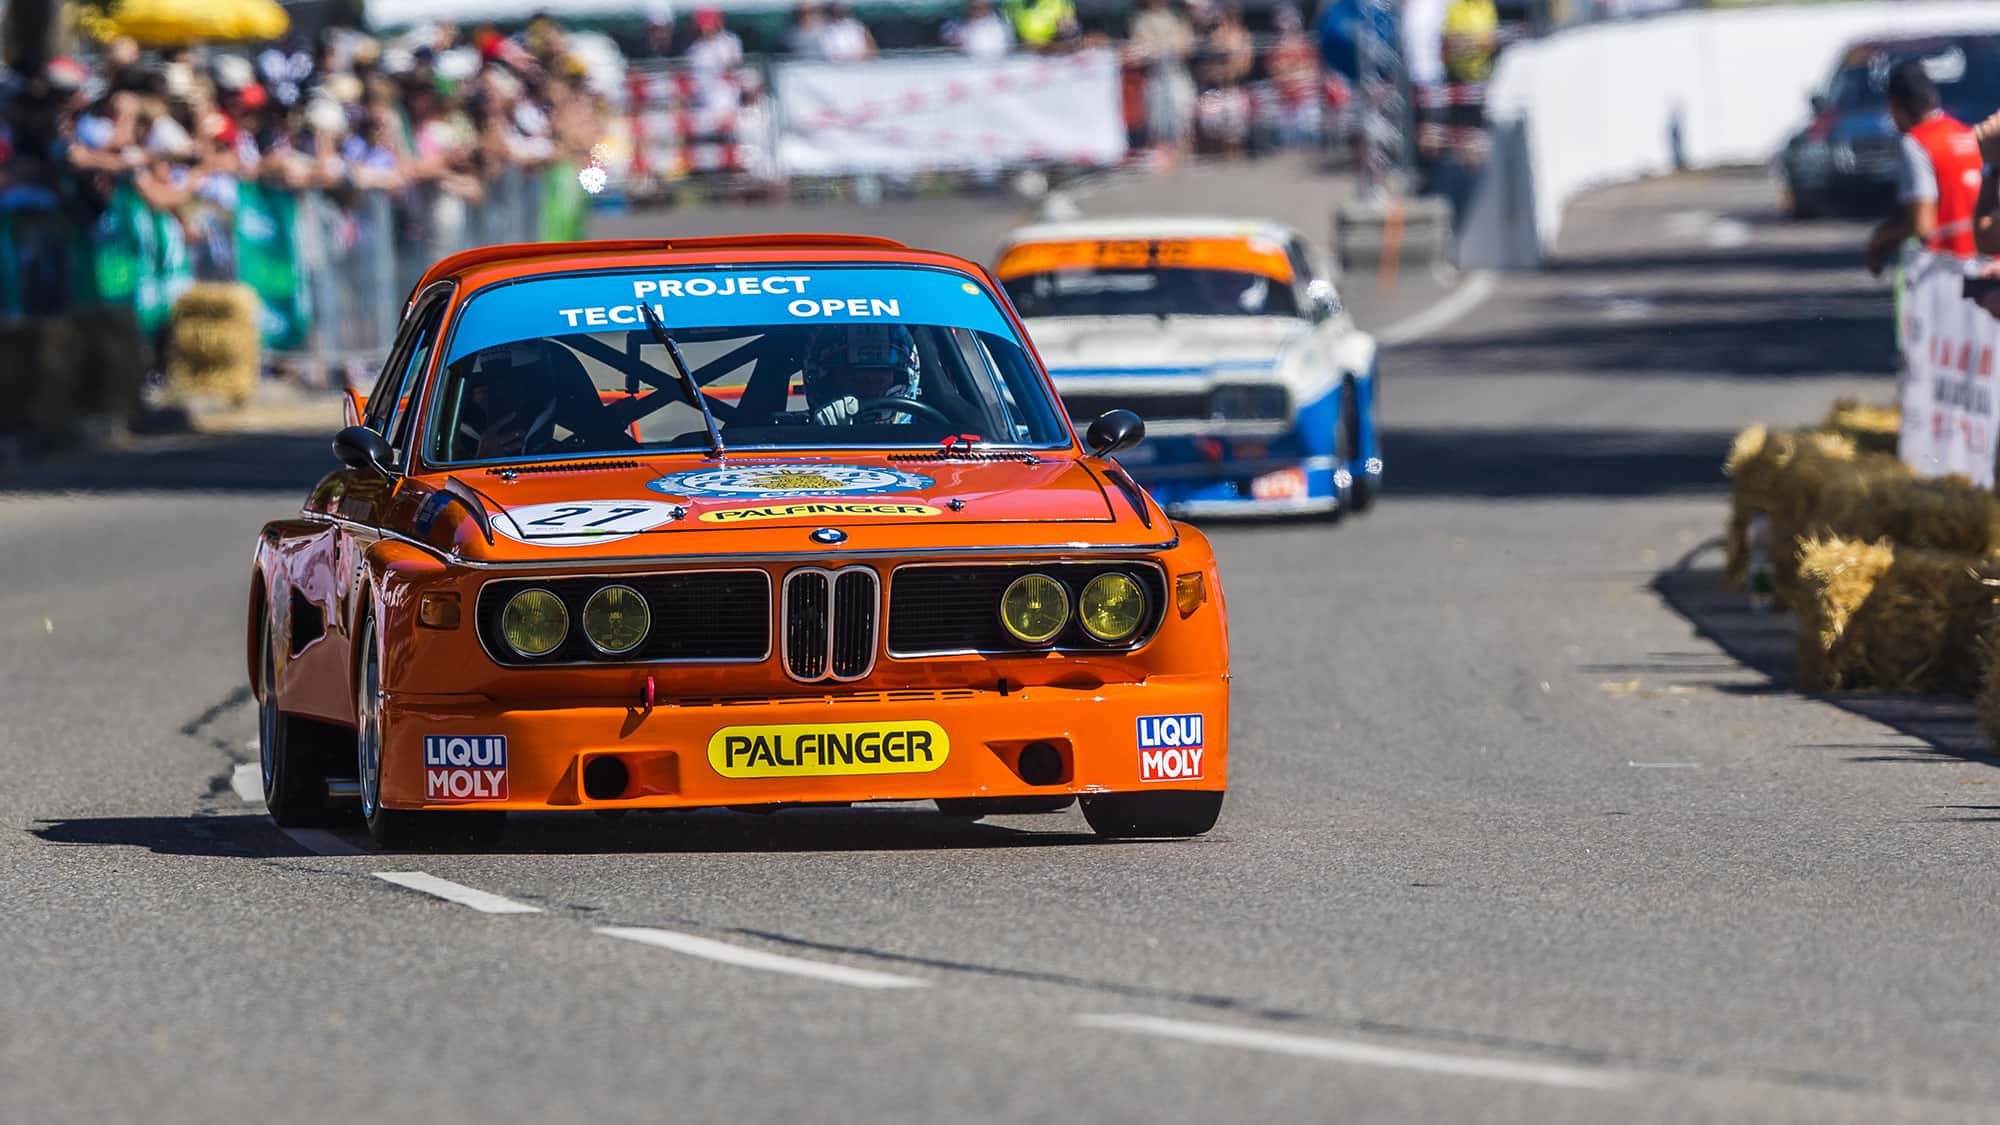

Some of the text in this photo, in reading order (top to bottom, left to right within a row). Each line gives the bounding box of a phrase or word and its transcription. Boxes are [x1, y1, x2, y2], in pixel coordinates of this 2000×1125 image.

[633, 276, 811, 298] PROJECT
[559, 298, 900, 326] TECH OPEN
[527, 507, 651, 527] 27
[716, 504, 926, 520] PALFINGER
[1140, 717, 1201, 746] LIQUI
[427, 738, 502, 767] LIQUI
[725, 731, 933, 768] PALFINGER
[1142, 748, 1203, 778] MOLY
[427, 770, 505, 798] MOLY
